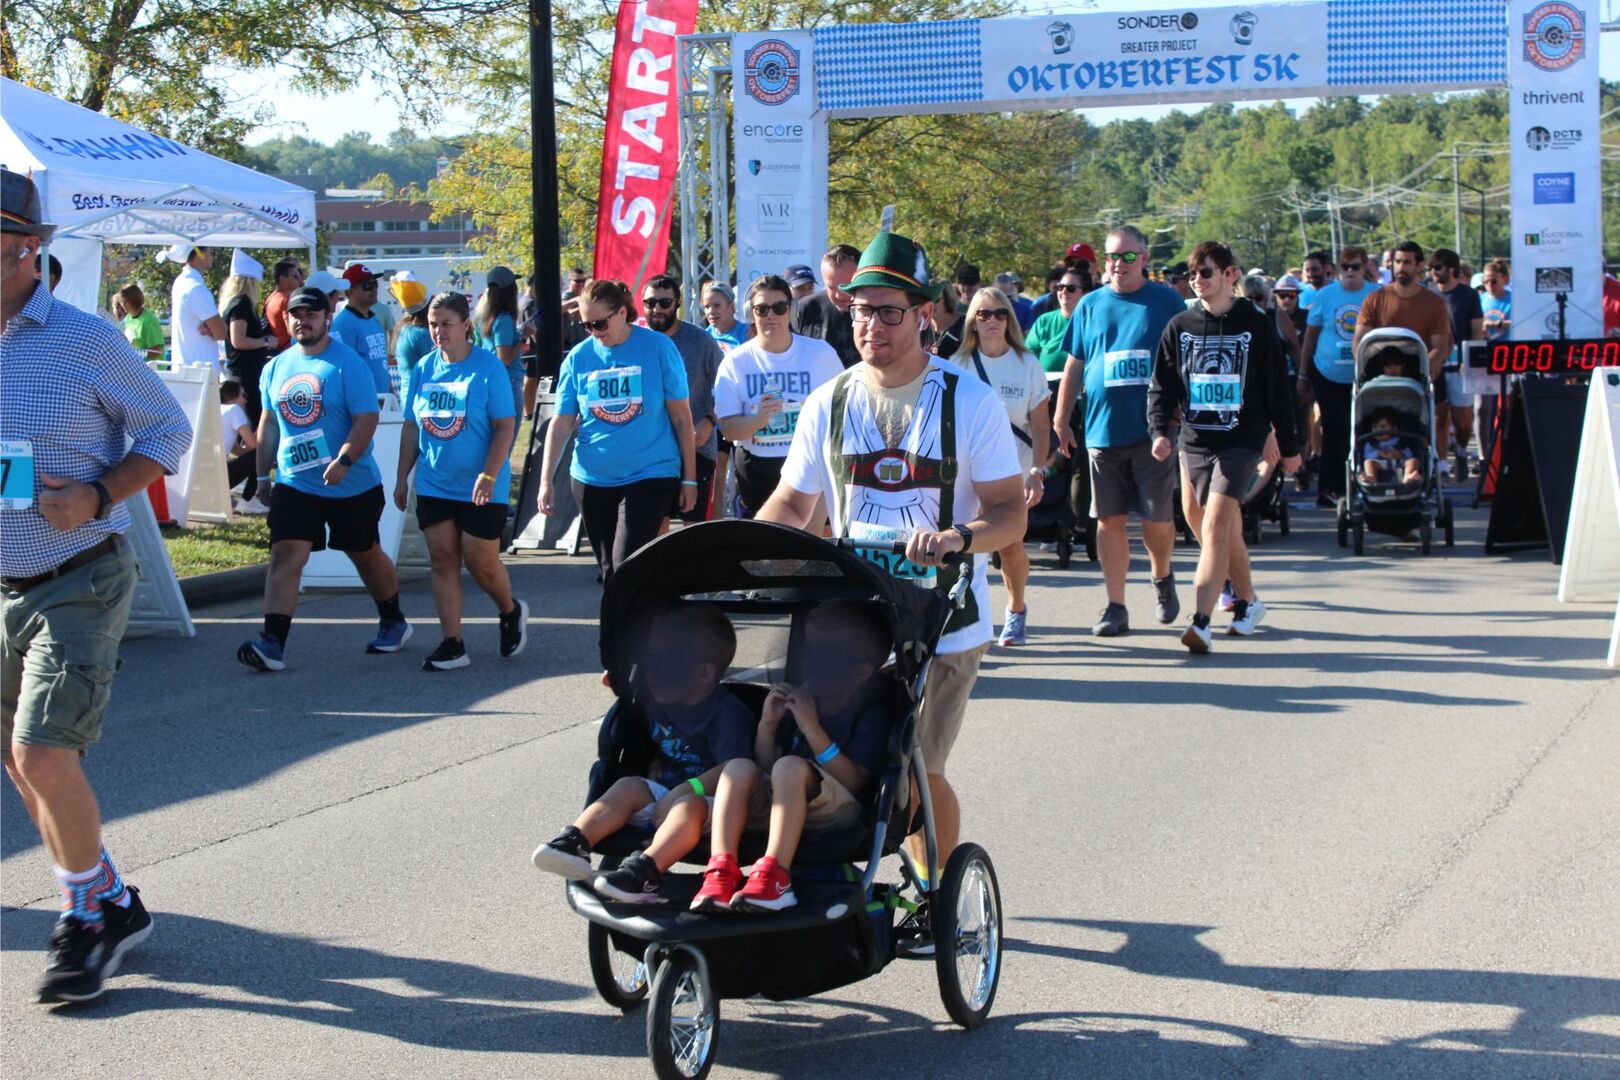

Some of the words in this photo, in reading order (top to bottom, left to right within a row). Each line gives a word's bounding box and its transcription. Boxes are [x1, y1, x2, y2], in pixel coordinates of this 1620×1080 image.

[1117, 14, 1184, 32] SONDER
[1121, 41, 1159, 53] GREATER
[1161, 39, 1198, 51] PROJECT
[1008, 54, 1246, 93] OKTOBERFEST
[1253, 52, 1300, 83] 5K
[748, 76, 797, 103] OKTOBERFEST
[1523, 90, 1585, 105] thrivent
[611, 0, 677, 239] START
[743, 124, 803, 137] encore
[1537, 177, 1572, 186] COYNE
[1112, 358, 1148, 378] 1095
[598, 376, 632, 398] 804
[745, 371, 811, 399] UNDER
[1197, 384, 1235, 403] 1094
[429, 391, 457, 410] 806
[289, 440, 319, 465] 805
[0, 458, 12, 496] 7
